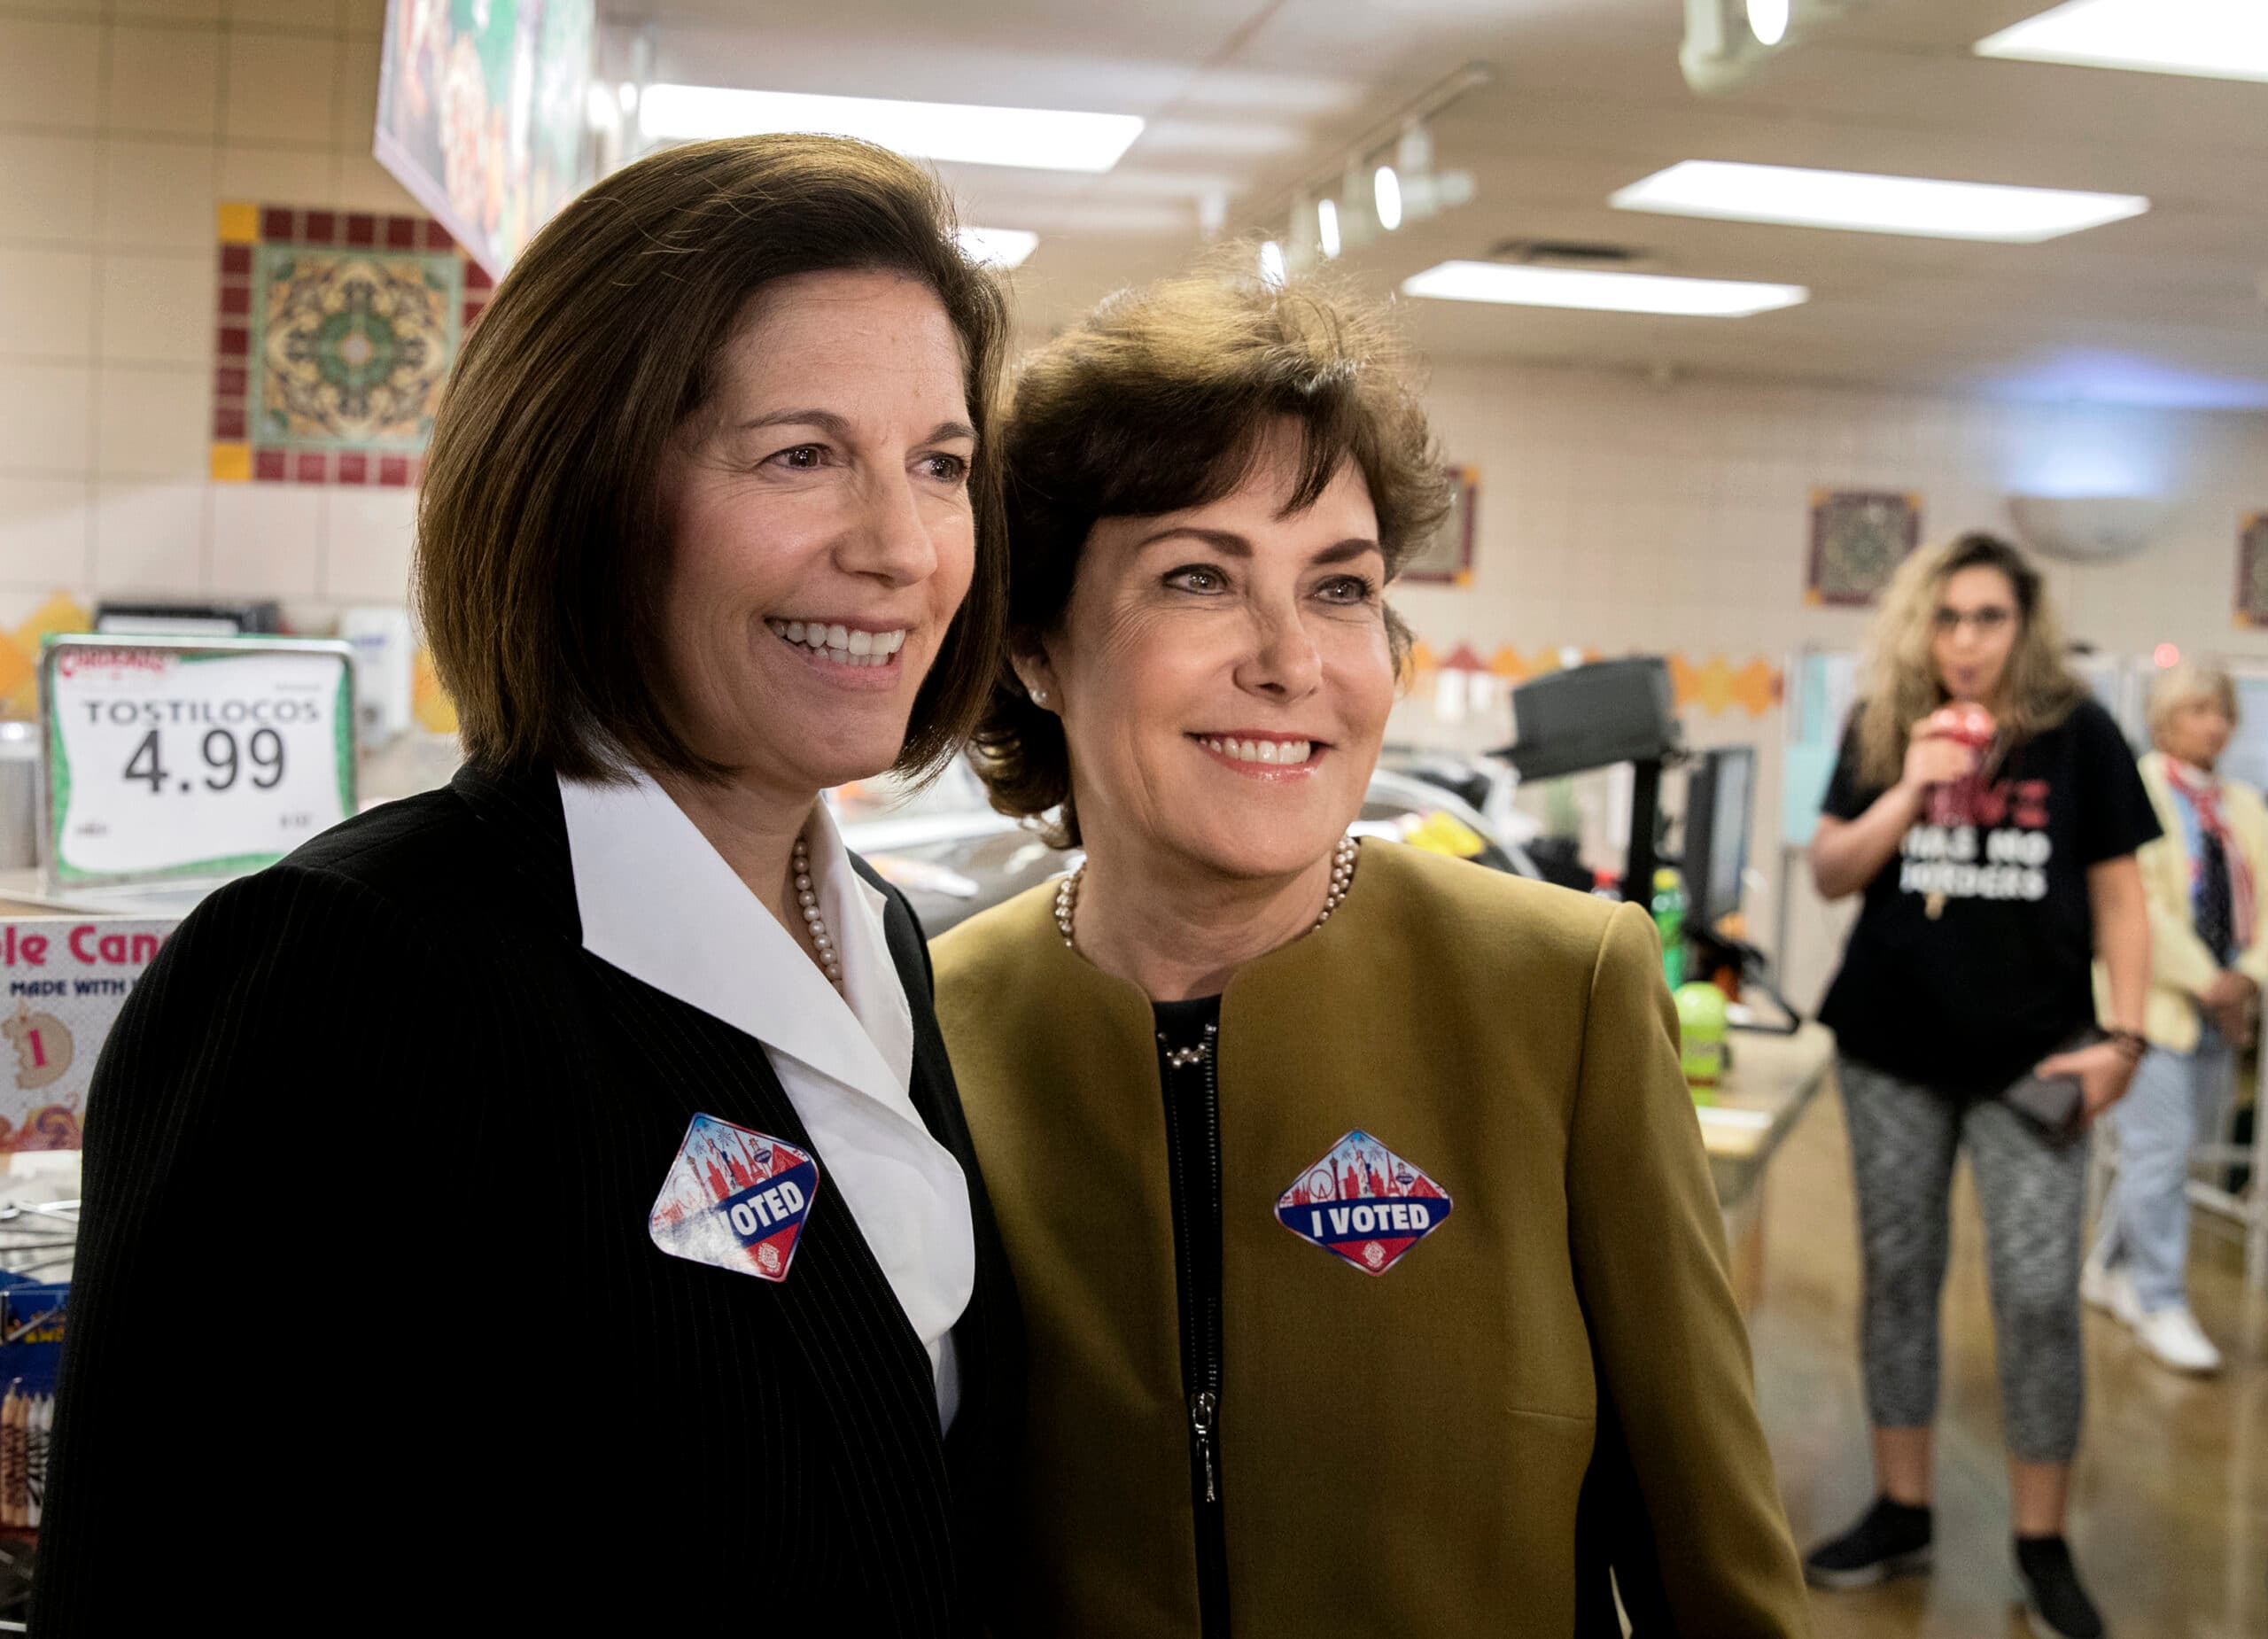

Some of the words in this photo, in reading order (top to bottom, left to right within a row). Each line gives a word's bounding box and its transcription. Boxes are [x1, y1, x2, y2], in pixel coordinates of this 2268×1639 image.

[81, 699, 320, 726] TOSTILOCOS
[124, 727, 286, 794] 4.99
[0, 924, 48, 967] le
[10, 978, 66, 997] MADE
[73, 979, 126, 996] WITH
[1311, 1210, 1324, 1238] I
[1329, 1203, 1431, 1236] VOTED
